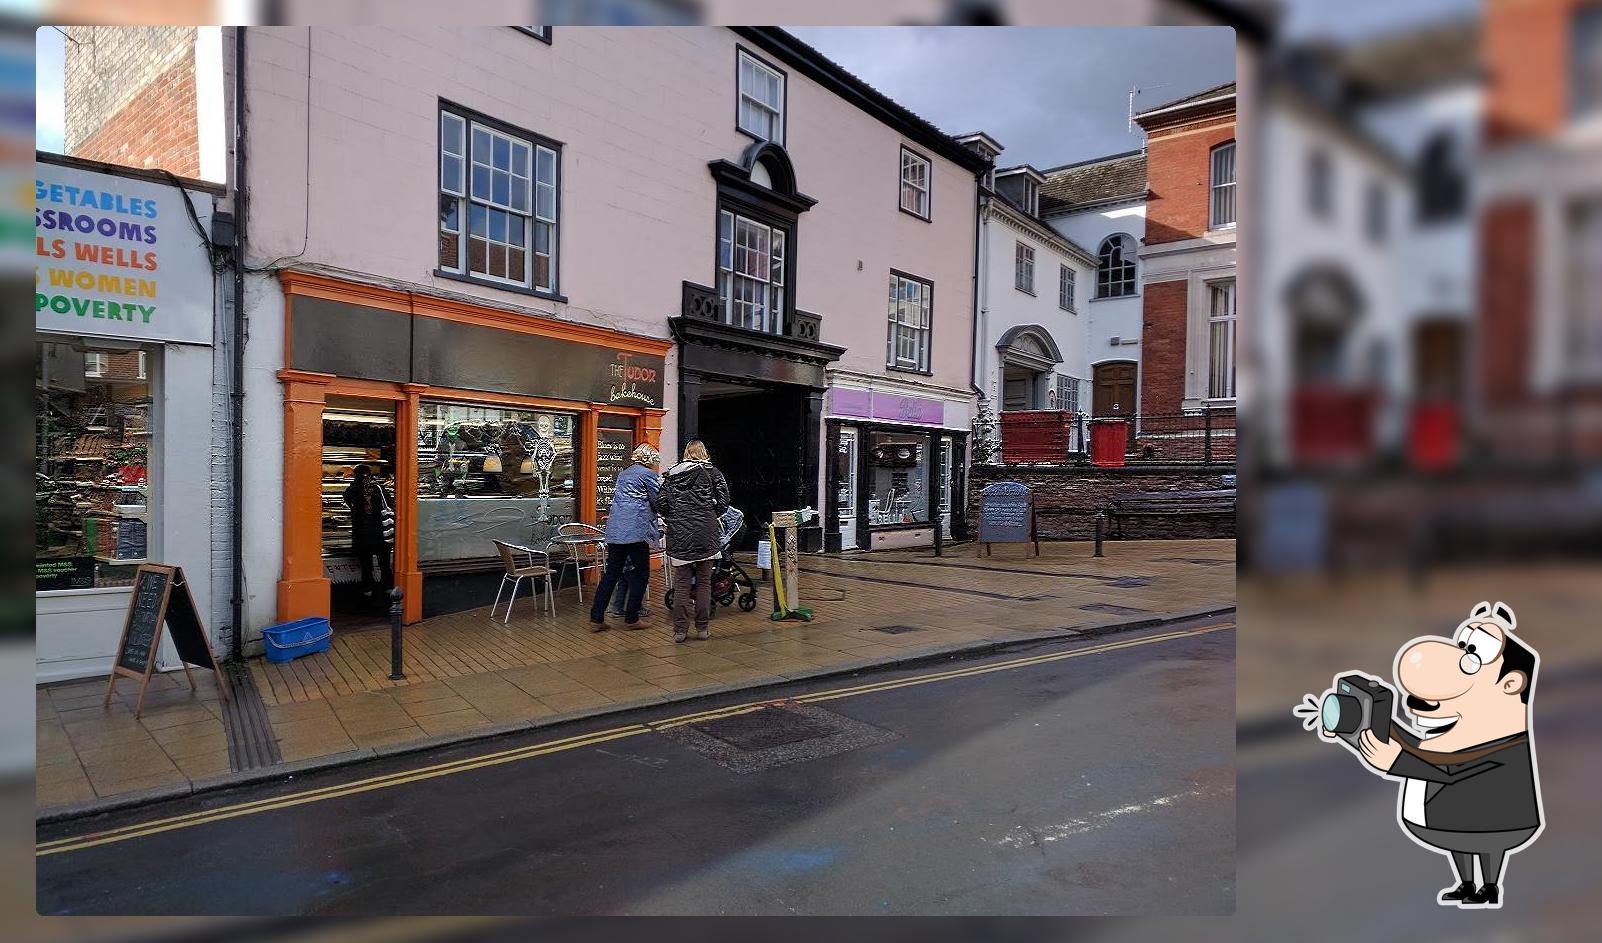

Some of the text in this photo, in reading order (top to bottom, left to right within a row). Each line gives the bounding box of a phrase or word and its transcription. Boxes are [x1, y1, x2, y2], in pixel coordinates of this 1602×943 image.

[36, 236, 158, 271] LS WELLS
[48, 267, 158, 298] WOMEN
[36, 292, 157, 324] POVERTY
[610, 363, 624, 378] THE
[609, 382, 655, 406] bakehouse
